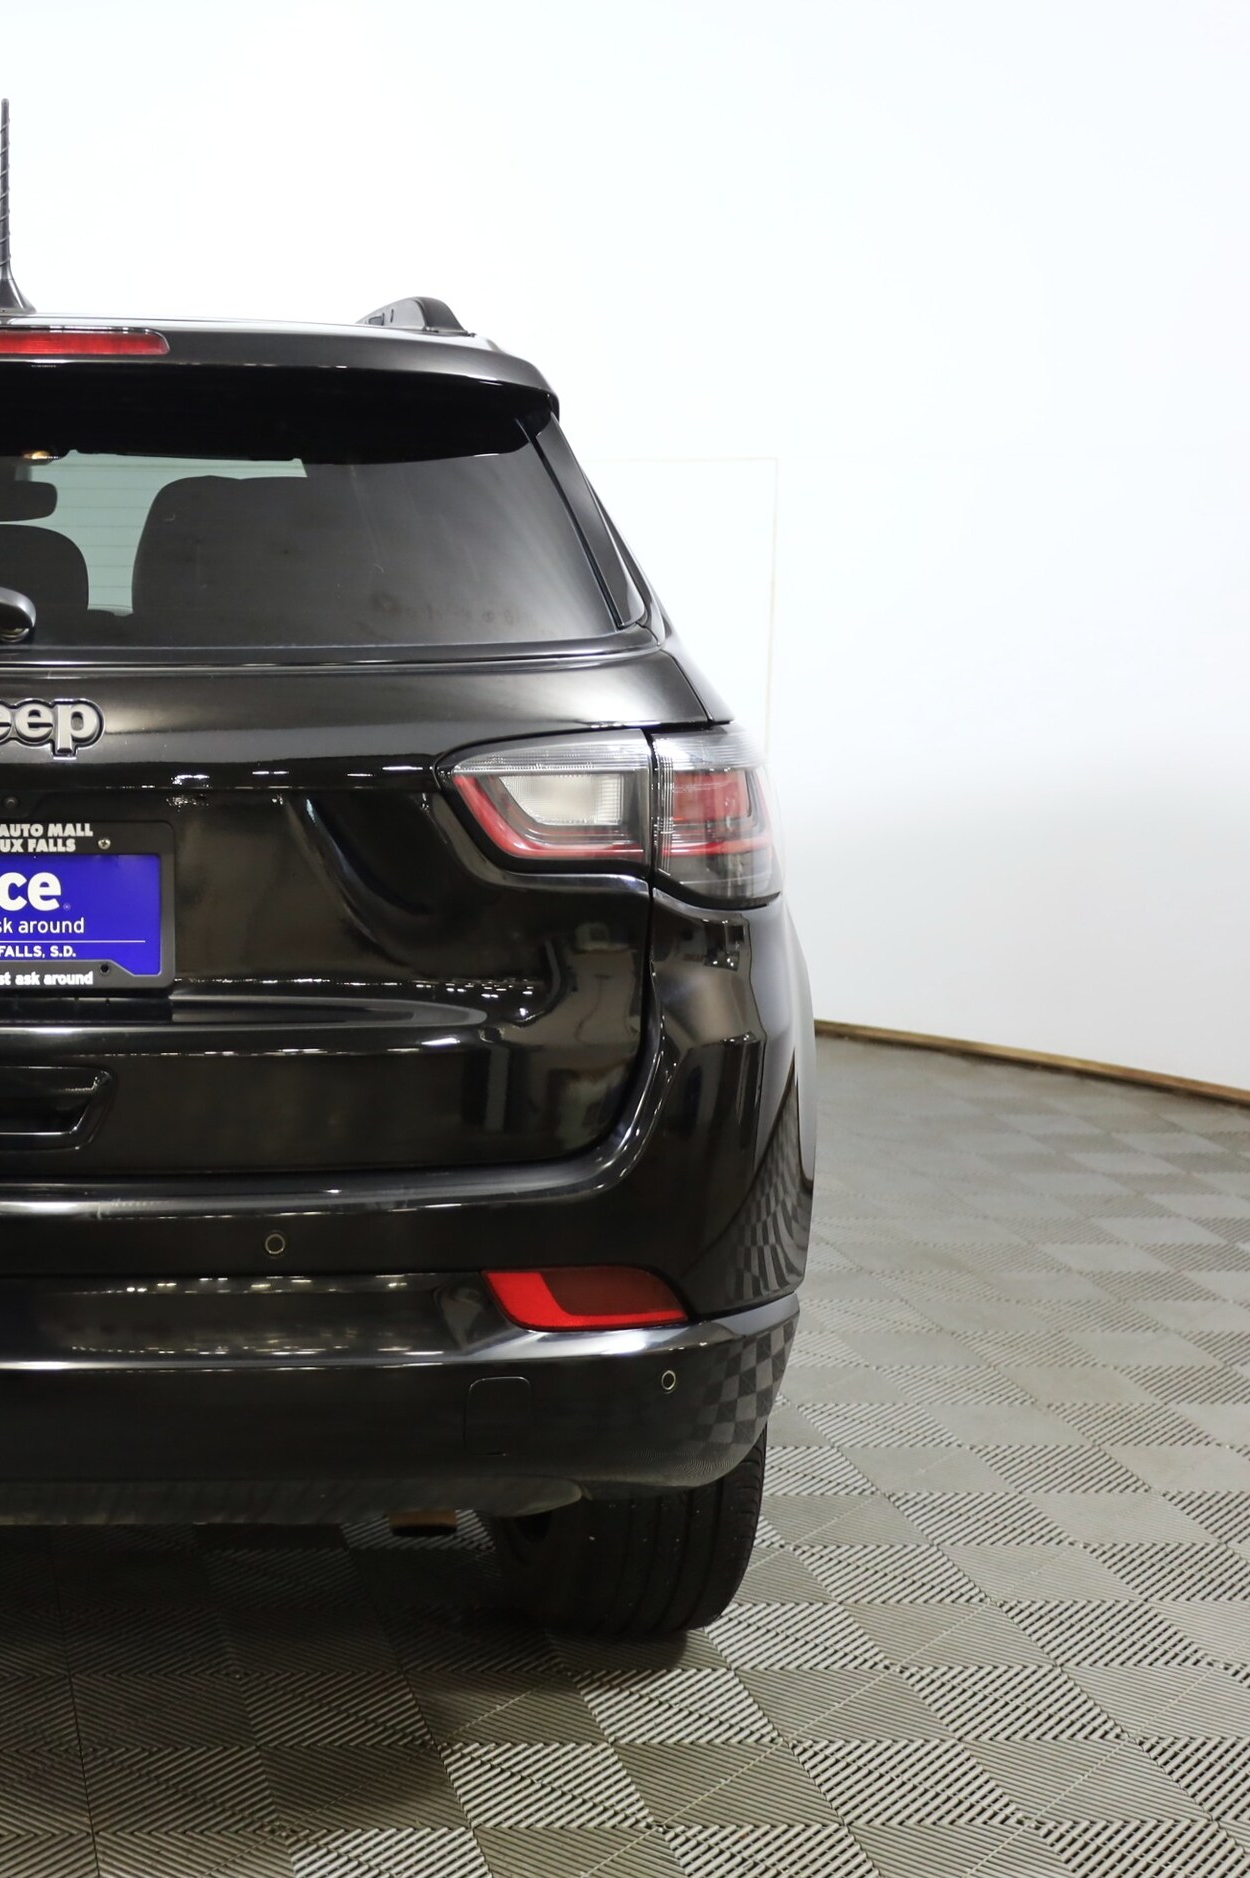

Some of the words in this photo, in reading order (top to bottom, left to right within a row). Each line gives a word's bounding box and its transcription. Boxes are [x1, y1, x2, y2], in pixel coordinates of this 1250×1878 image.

[48, 823, 93, 837] MALL
[27, 838, 76, 852] FALLS
[18, 917, 85, 934] around
[50, 945, 77, 958] S.D.
[15, 971, 39, 986] ask
[44, 971, 94, 986] around
